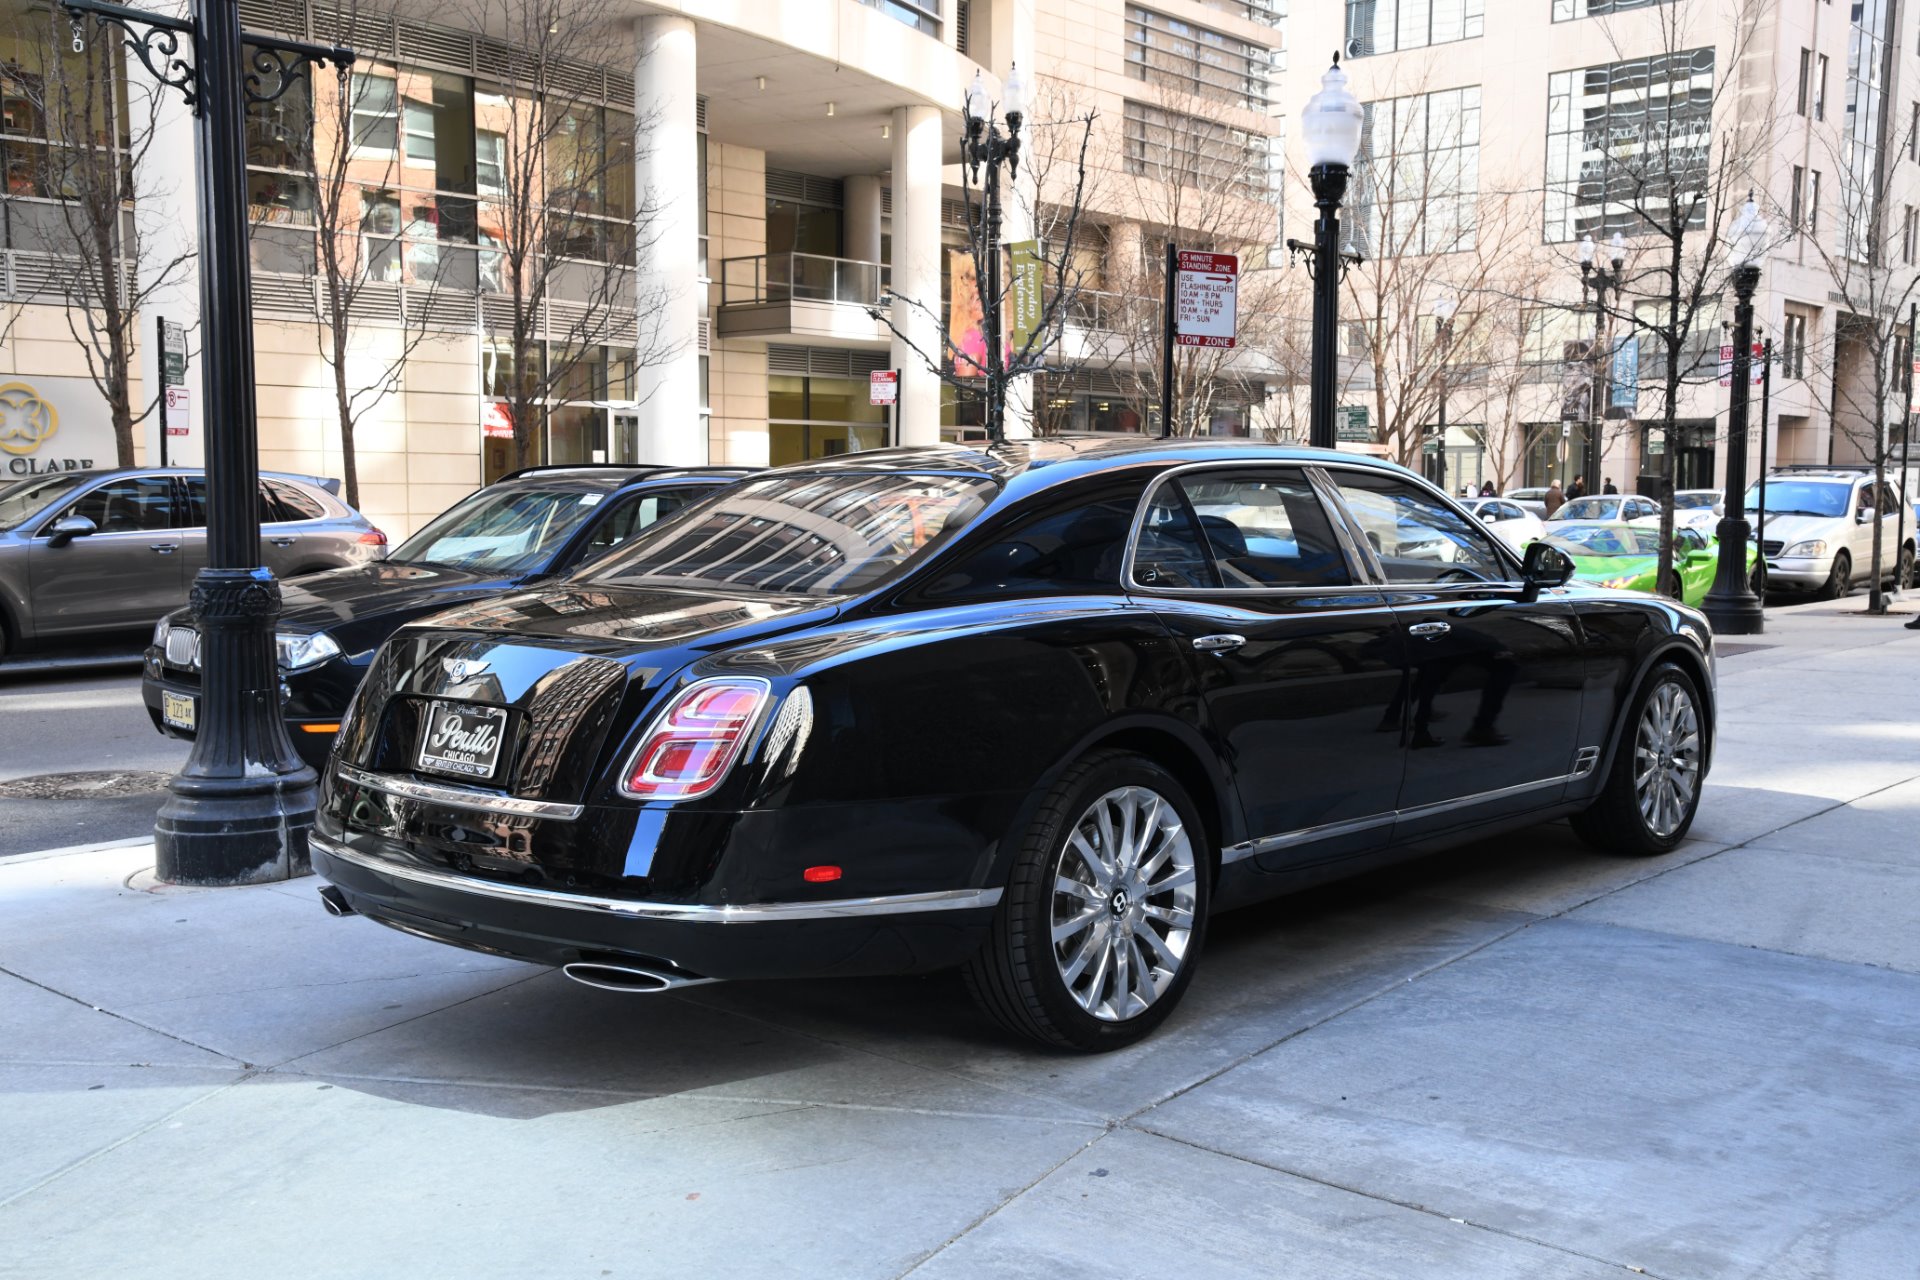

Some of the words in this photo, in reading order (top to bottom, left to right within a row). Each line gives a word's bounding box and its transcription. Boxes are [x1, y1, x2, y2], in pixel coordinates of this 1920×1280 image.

[1190, 254, 1213, 263] MINUTE
[1181, 261, 1212, 271] STANDING
[1215, 264, 1232, 273] ZONE
[1027, 263, 1037, 318] Everyday
[1180, 282, 1211, 292] FLASHING
[1212, 285, 1234, 293] LIGHTS
[1202, 299, 1223, 308] THURS
[1196, 315, 1210, 323] SUN
[1180, 335, 1200, 345] TOW
[1205, 336, 1231, 347] ZONE
[9, 458, 94, 475] CLARE
[455, 704, 479, 715] Perillo
[431, 714, 497, 756] Perillo
[443, 749, 476, 763] CHICAGO
[435, 760, 453, 769] BENTLEY
[453, 762, 475, 773] CHICAGO
